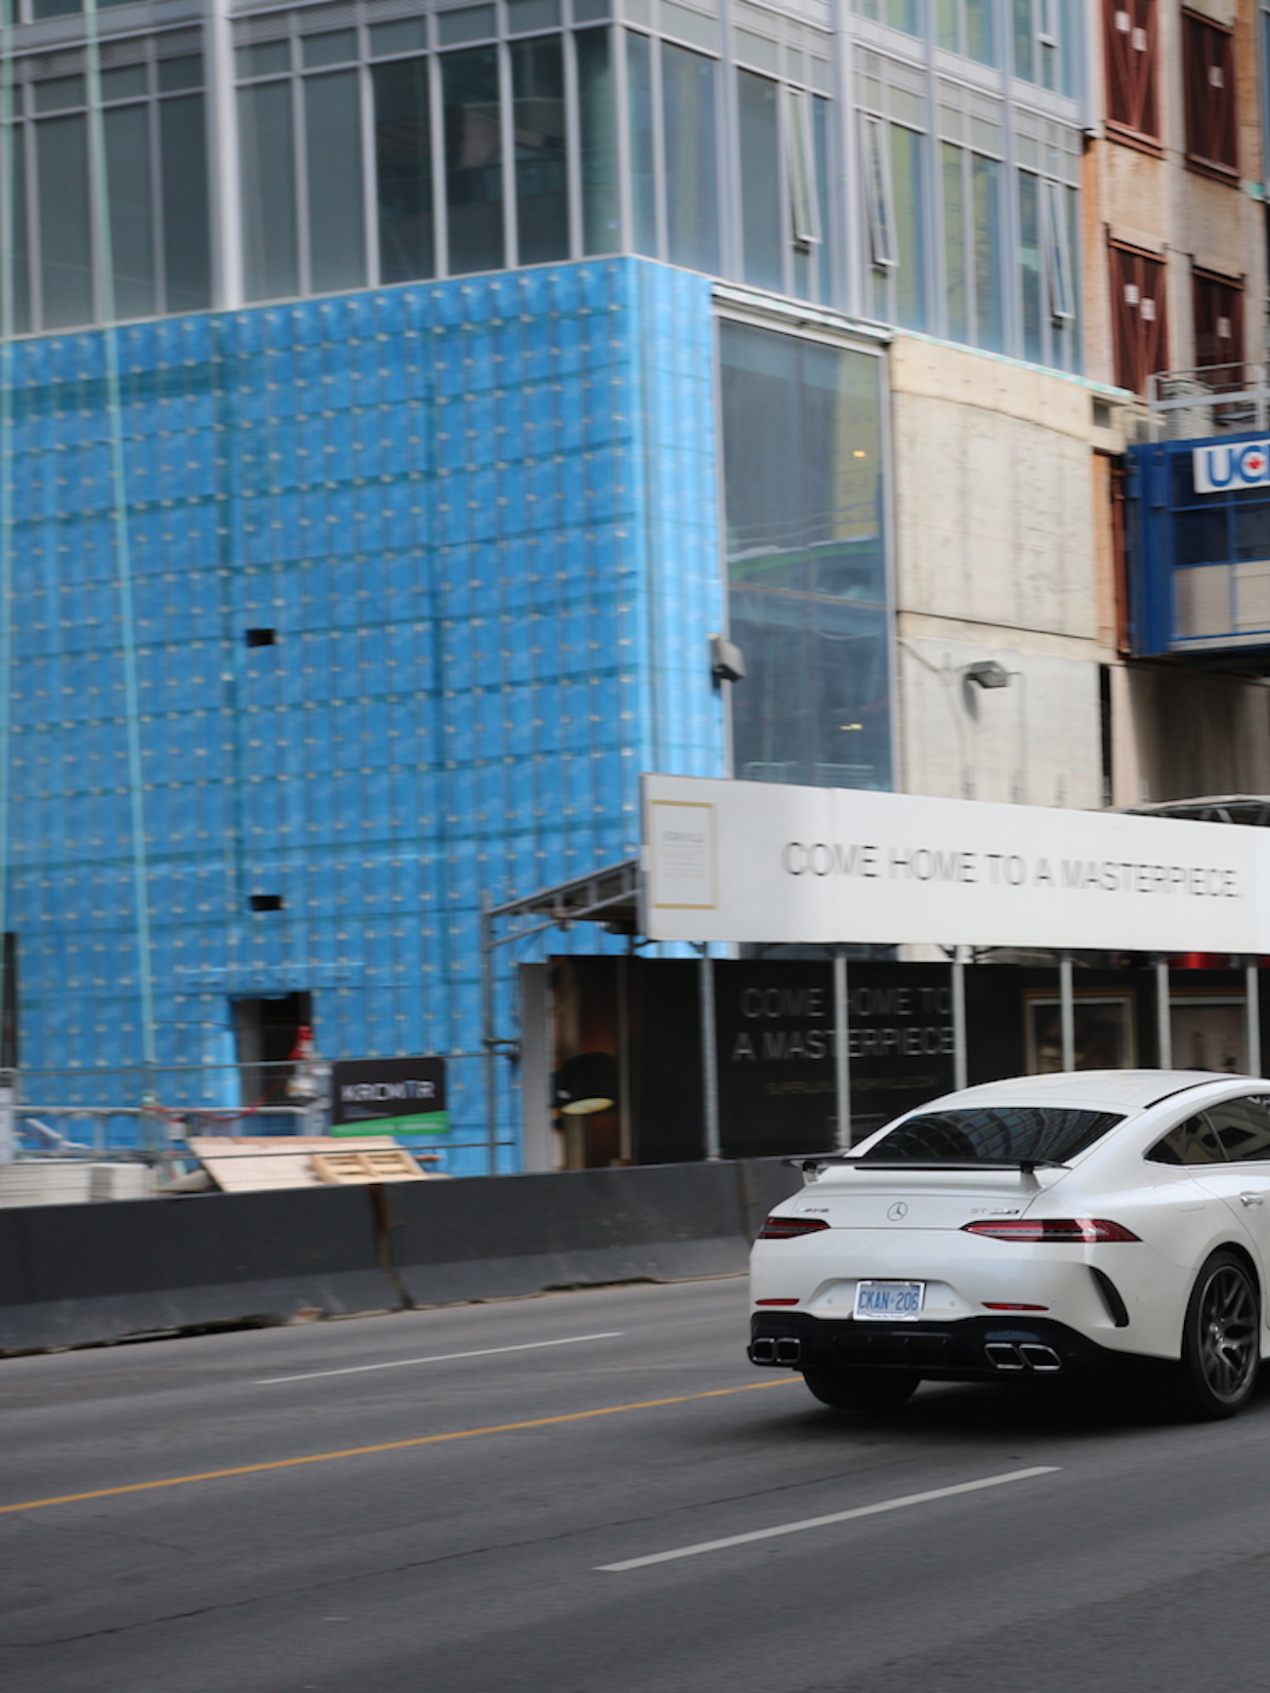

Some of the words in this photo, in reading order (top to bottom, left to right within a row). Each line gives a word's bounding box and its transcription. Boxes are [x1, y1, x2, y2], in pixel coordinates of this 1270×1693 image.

[782, 841, 880, 878] COME
[888, 846, 977, 884] HOME
[984, 852, 1028, 887] TO
[1033, 857, 1056, 888] A
[739, 987, 825, 1018] COME
[848, 986, 913, 1016] OME
[918, 986, 954, 1016] TO
[731, 1031, 757, 1061] A
